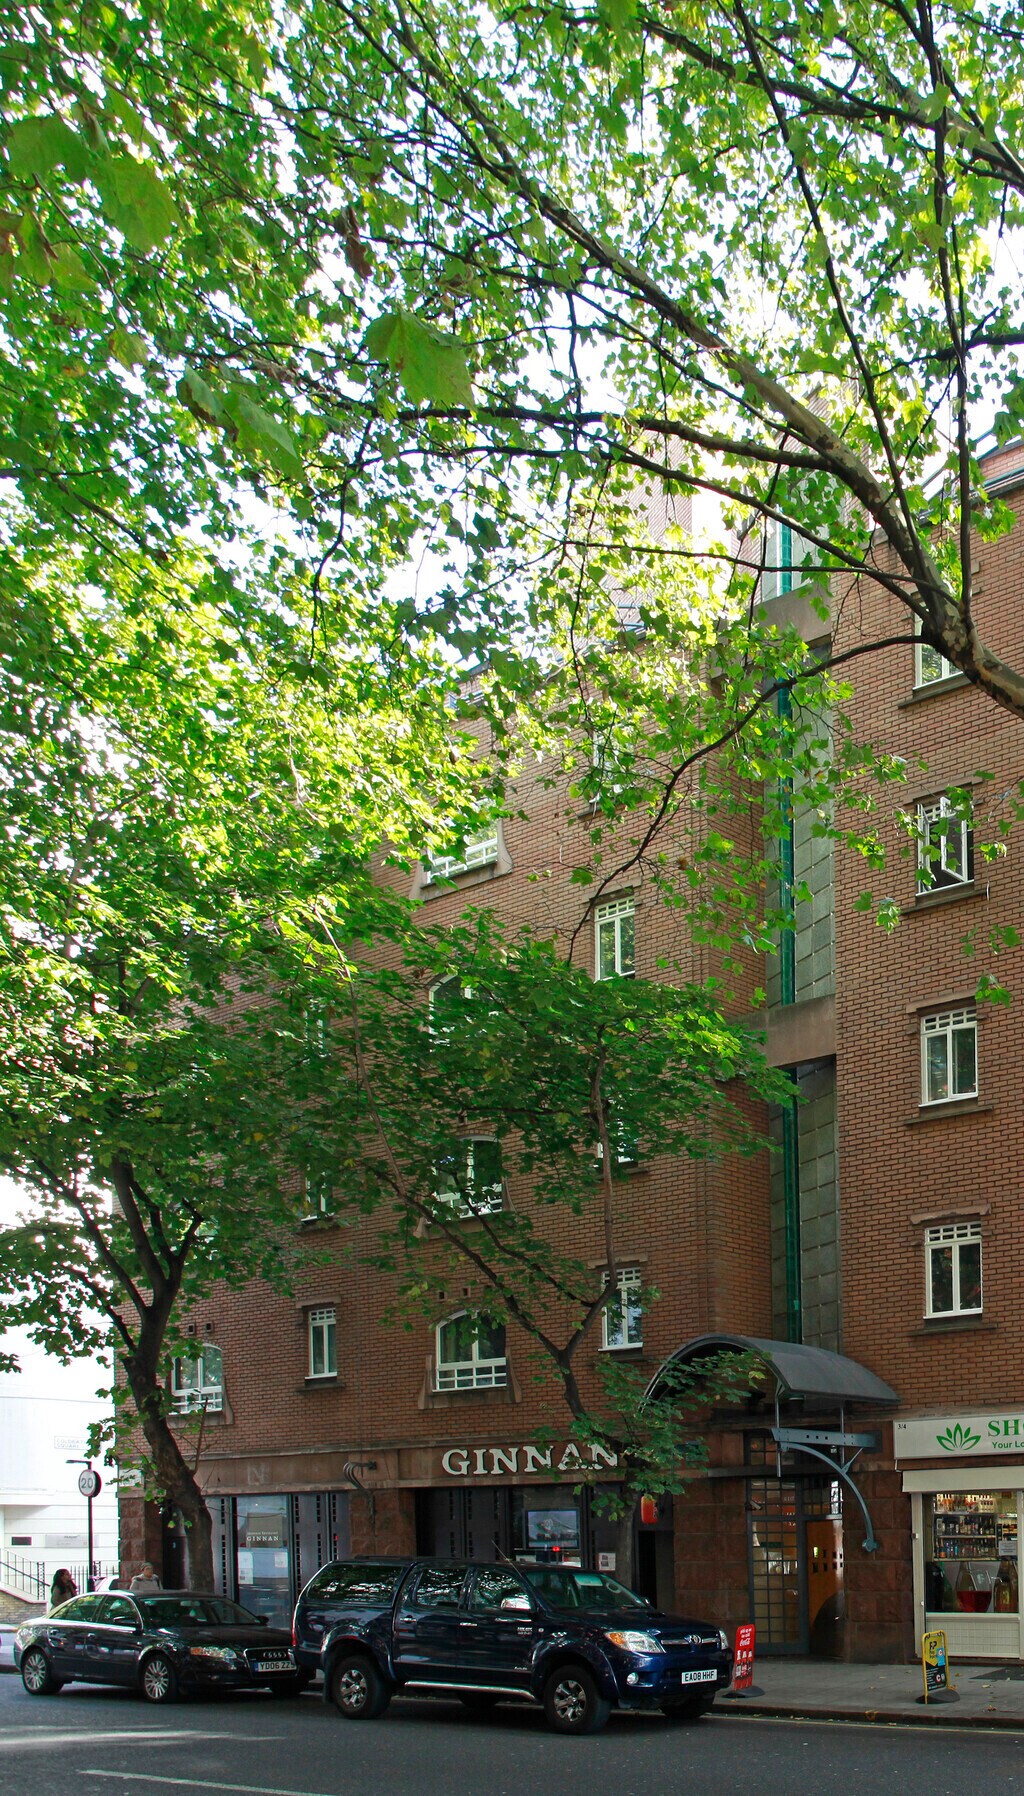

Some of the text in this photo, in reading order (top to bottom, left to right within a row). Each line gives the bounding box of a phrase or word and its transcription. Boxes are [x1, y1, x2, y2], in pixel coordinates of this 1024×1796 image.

[991, 1440, 1012, 1449] Your
[441, 1443, 618, 1475] GINNAN
[81, 1477, 94, 1489] 20
[684, 1670, 715, 1682] EA08 HHF
